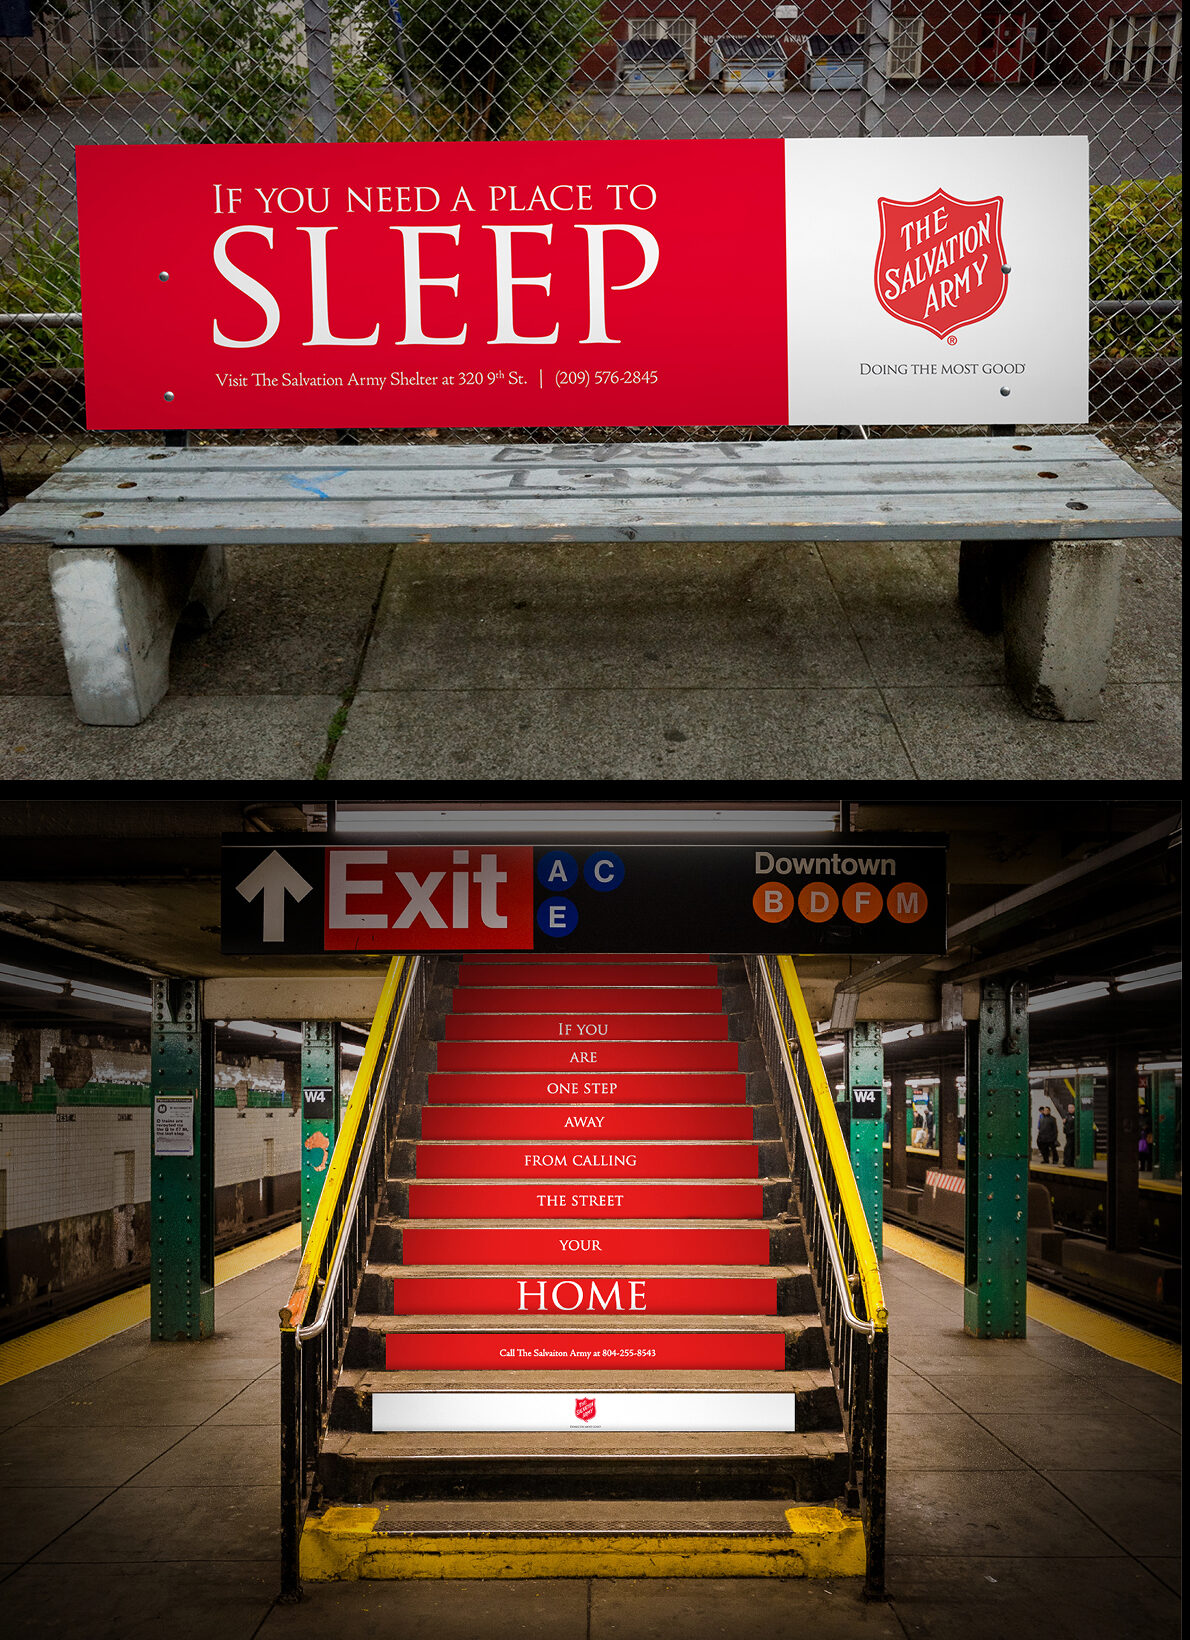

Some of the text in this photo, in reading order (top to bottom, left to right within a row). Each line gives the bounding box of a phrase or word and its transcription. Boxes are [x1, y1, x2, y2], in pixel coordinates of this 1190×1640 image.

[213, 184, 657, 214] IF YOU NEED A PLACE TO
[900, 206, 949, 251] THE
[884, 212, 991, 300] SALVATION
[213, 224, 660, 348] SLEEP
[923, 253, 988, 319] ARMY
[215, 369, 658, 390] Visit The Salvation Army Shelter at 320 9th St. (209) 576-2845
[860, 363, 908, 375] DOING
[911, 363, 937, 375] THE
[941, 363, 978, 375] MOST
[547, 859, 615, 883] A C
[755, 851, 896, 875] Downtown
[328, 850, 508, 929] Exit
[764, 890, 919, 914] B D F M
[549, 905, 567, 928] E
[558, 1022, 608, 1036] IF YOU
[569, 1051, 598, 1063] ARE
[304, 1091, 326, 1103] W4
[547, 1082, 618, 1094] ONE STEP
[854, 1091, 876, 1103] W4
[564, 1116, 605, 1128] AWAY
[524, 1154, 637, 1166] FROM CALLING
[537, 1195, 624, 1207] THE STREET
[559, 1239, 602, 1251] YOUR
[517, 1281, 647, 1311] HOME
[499, 1348, 657, 1360] Call The Salvaiton Army at 804-255-8543
